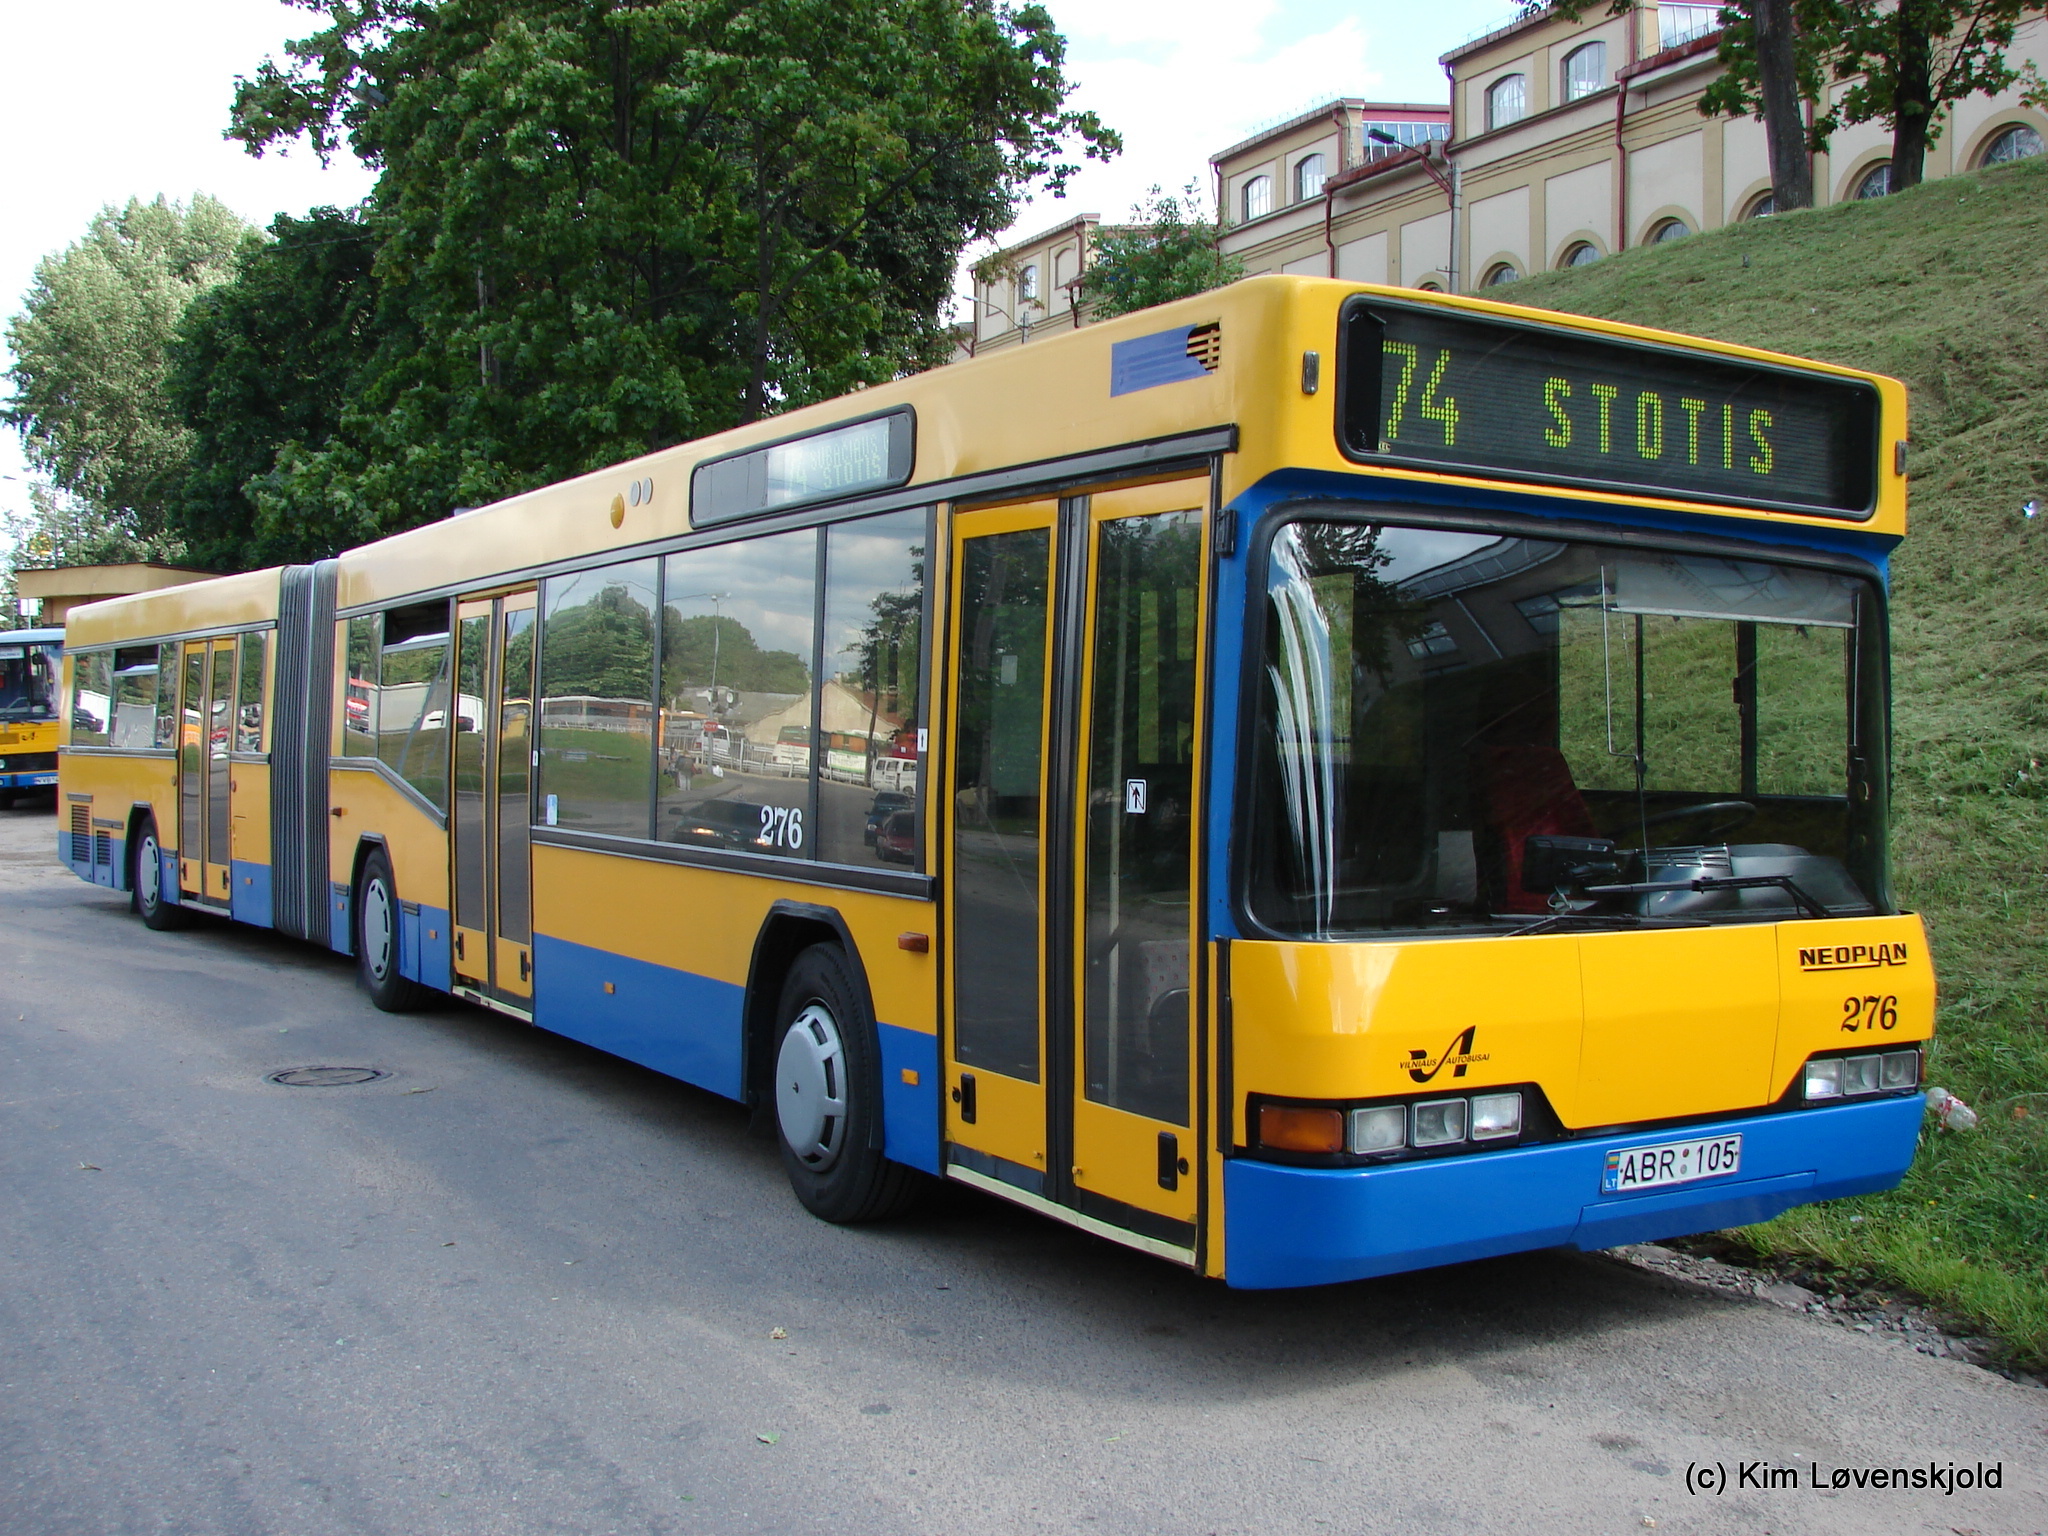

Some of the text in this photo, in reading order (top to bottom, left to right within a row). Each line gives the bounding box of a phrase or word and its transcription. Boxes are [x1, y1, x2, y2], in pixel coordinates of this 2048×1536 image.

[1382, 341, 1773, 475] 74 STOTIS
[822, 452, 882, 489] STOTIS
[760, 804, 803, 849] 276
[1799, 942, 1907, 968] NEOPLAN
[1840, 995, 1897, 1032] 276
[1399, 1053, 1491, 1070] VILNIAUS AUTOBUSAI
[1622, 1140, 1736, 1185] ABR 105
[1605, 1178, 1617, 1189] LT
